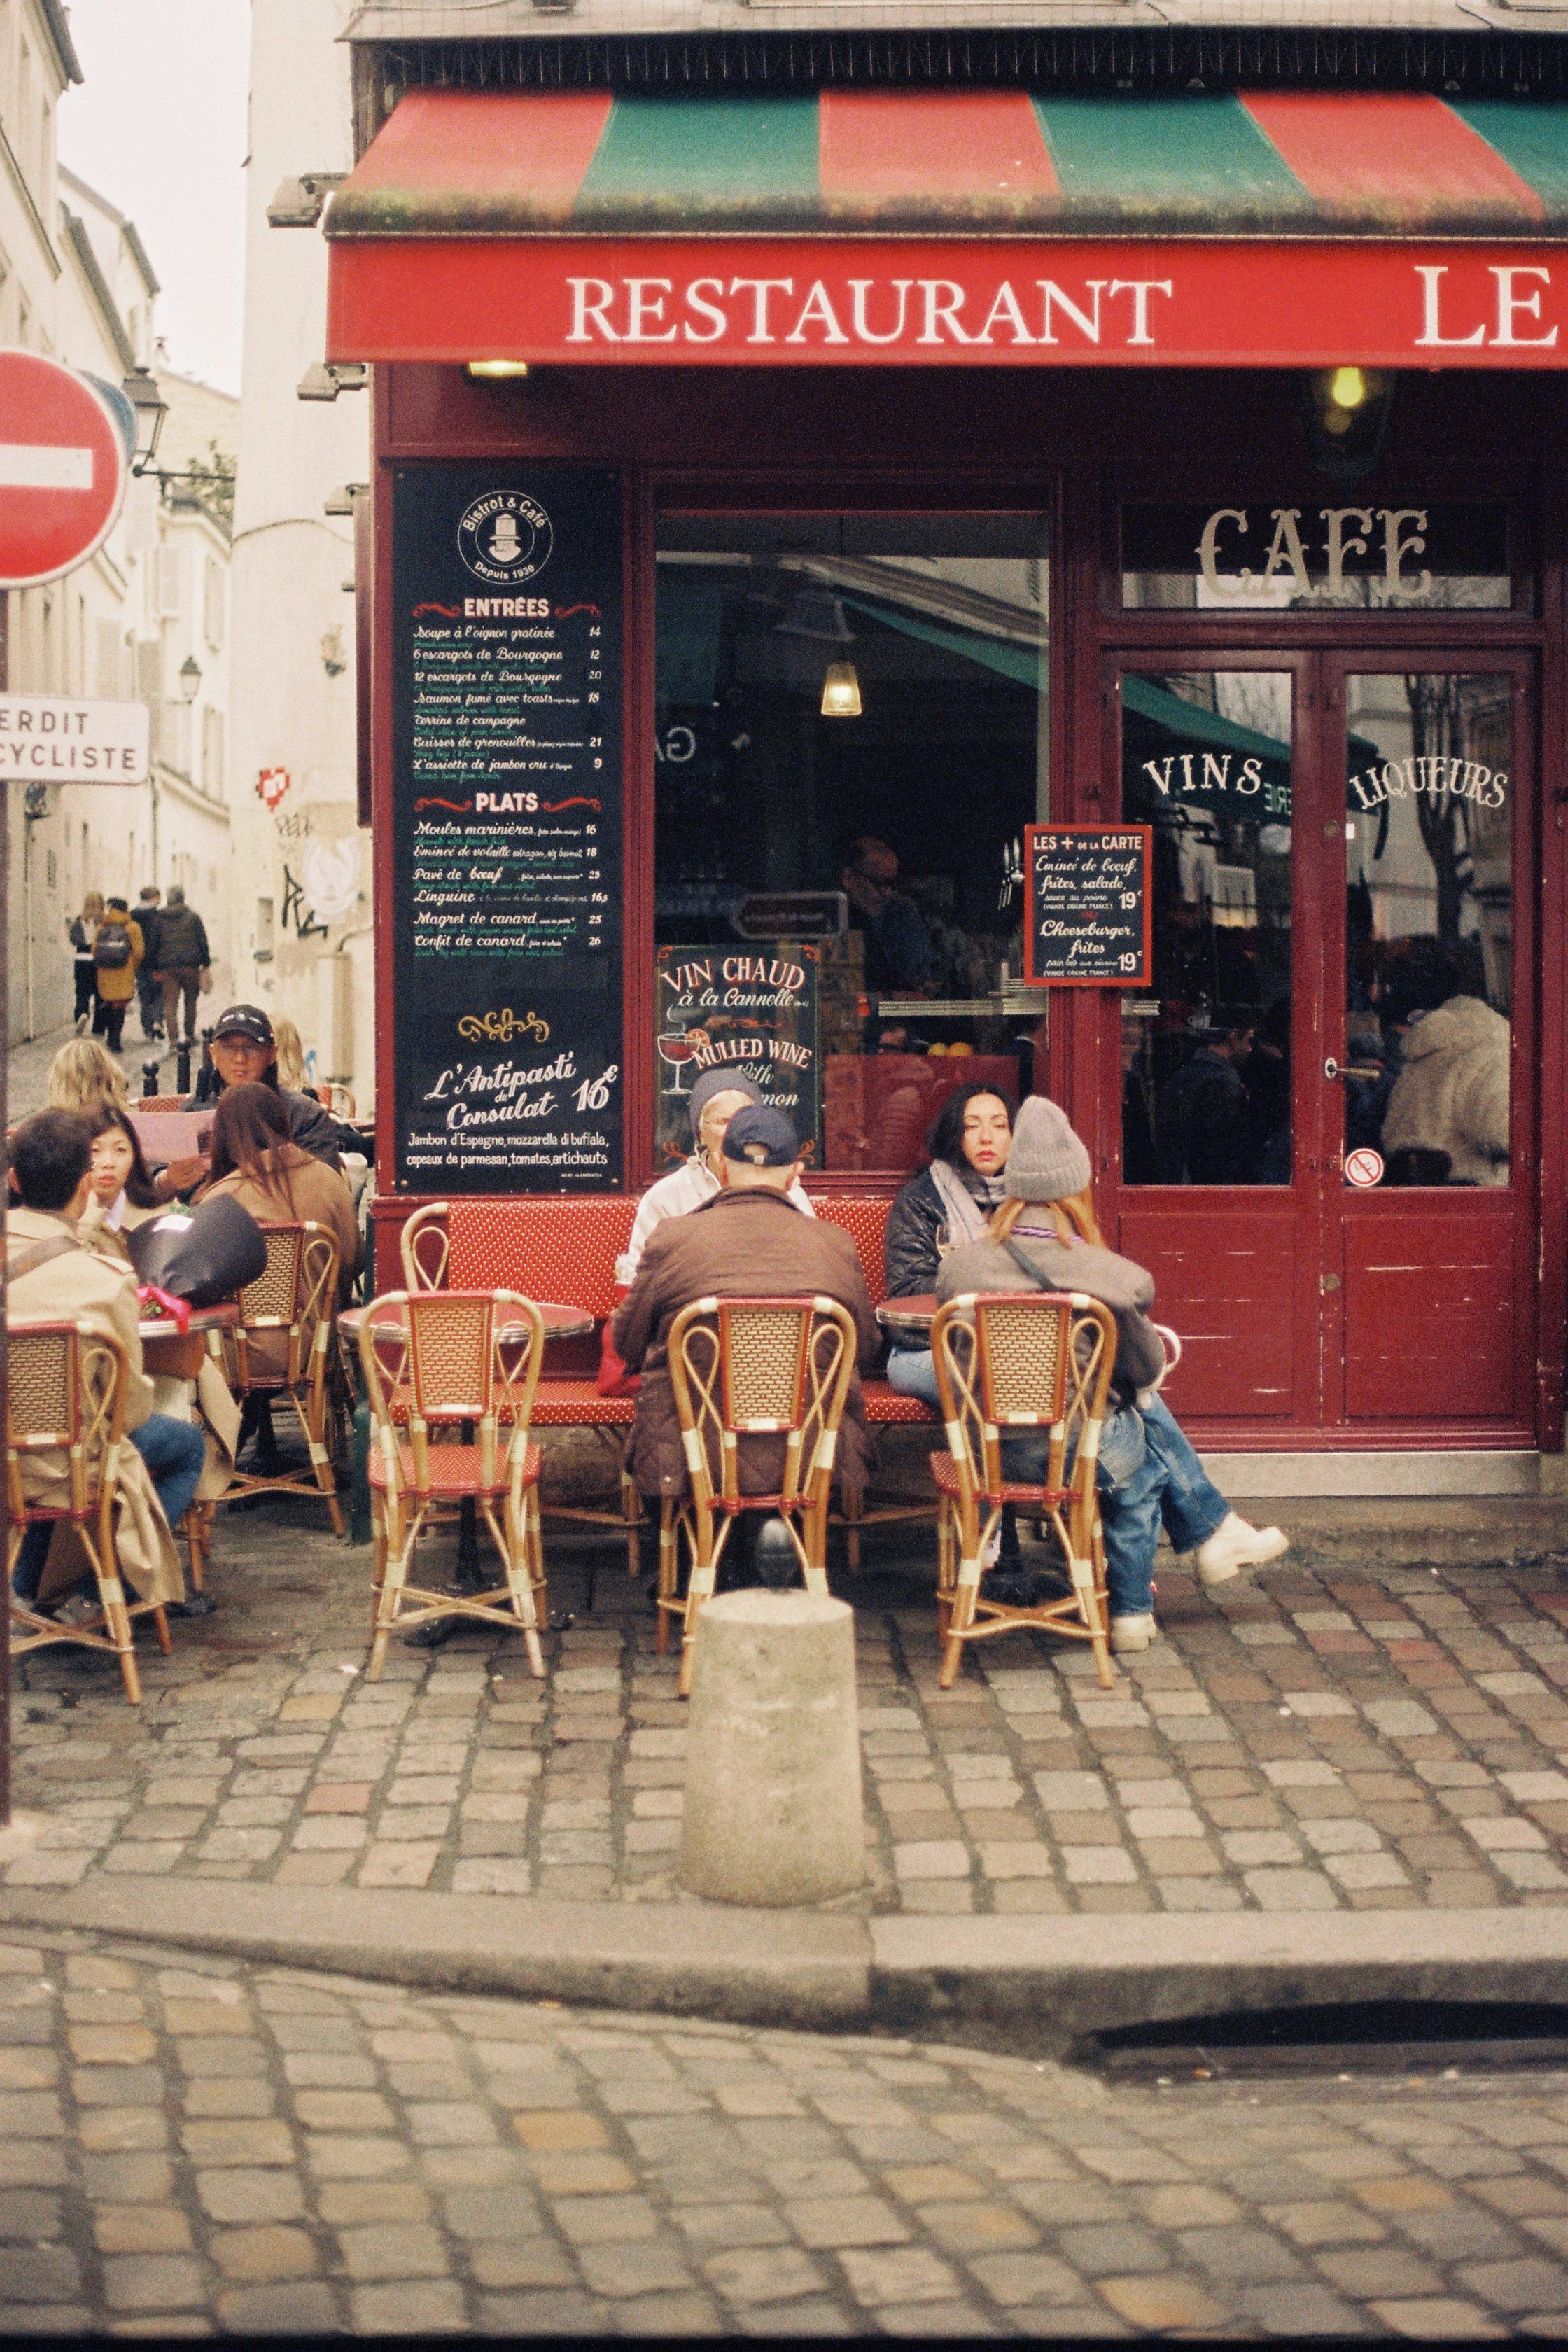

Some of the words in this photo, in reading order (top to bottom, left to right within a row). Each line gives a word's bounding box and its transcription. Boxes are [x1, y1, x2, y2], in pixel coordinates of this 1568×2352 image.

[564, 276, 1172, 344] RESTAURANT
[1414, 266, 1558, 345] LE
[463, 496, 503, 531] Bistrot
[507, 497, 516, 507] &
[520, 500, 547, 528] Café
[1194, 507, 1432, 600] CAFE
[475, 561, 509, 580] Depuis
[512, 564, 535, 578] 1930
[464, 597, 550, 617] ENTRÉES
[413, 626, 451, 640] Soupe
[454, 627, 462, 638] à
[465, 626, 507, 640] l'oignon
[511, 626, 555, 641] gratinée
[589, 626, 601, 637] 14
[414, 650, 420, 659] 6
[423, 650, 473, 664] escargots
[476, 649, 491, 659] de
[496, 647, 563, 663] Bourgogne
[591, 650, 599, 659] 12
[414, 672, 424, 682] 12
[427, 671, 476, 684] escargots
[481, 671, 494, 682] de
[499, 671, 561, 685] Bourgogne
[414, 692, 461, 704] Saumon
[465, 693, 491, 707] fumé
[523, 694, 553, 703] toasts
[414, 715, 452, 725] Terrine
[456, 715, 469, 725] de
[472, 717, 525, 728] campagne
[414, 736, 455, 748] Cuisses
[458, 737, 471, 748] de
[475, 736, 536, 749] grenouilles
[589, 737, 602, 748] 21
[413, 759, 468, 770] L'assiette
[471, 759, 484, 770] de
[489, 759, 525, 773] jambon
[594, 758, 602, 769] 9
[1143, 754, 1262, 795] VINS
[1350, 757, 1508, 810] LIQUEURS
[476, 792, 538, 812] PLATS
[414, 822, 461, 834] Moules
[585, 825, 596, 834] 16
[414, 844, 455, 857] Emincé
[458, 845, 470, 857] de
[473, 846, 511, 857] volaille
[587, 848, 596, 857] 18
[1034, 836, 1057, 850] LES
[1061, 836, 1074, 850] +
[1102, 836, 1142, 850] CARTE
[1035, 855, 1079, 871] Emincé
[1082, 858, 1096, 871] de
[413, 867, 442, 880] Pavé
[447, 868, 462, 879] de
[470, 867, 503, 883] bœuf
[1082, 875, 1126, 890] salade,
[413, 890, 475, 906] Linguine
[414, 911, 465, 927] Magret
[470, 911, 486, 924] de
[491, 911, 538, 924] canard
[589, 914, 602, 924] 25
[1040, 920, 1135, 939] Cheeseburger,
[414, 934, 451, 951] Confit
[456, 934, 472, 945] de
[477, 934, 526, 946] canard
[589, 937, 601, 945] 26
[1069, 939, 1105, 958] frites
[661, 959, 712, 992] VIN
[722, 957, 805, 990] CHAUD
[677, 989, 693, 1007] à
[699, 988, 719, 1007] la
[723, 987, 794, 1007] Cannelle
[692, 1039, 763, 1070] MULLED
[769, 1040, 813, 1069] WINE
[424, 1051, 577, 1100] L'Antipasti
[495, 1089, 508, 1102] du
[571, 1064, 619, 1112] 16€
[447, 1092, 559, 1130] Consulat
[408, 1132, 447, 1146] Jambon
[507, 1133, 557, 1145] mozzarella
[561, 1132, 569, 1145] di
[406, 1155, 442, 1168] copeaux
[446, 1152, 458, 1165] de
